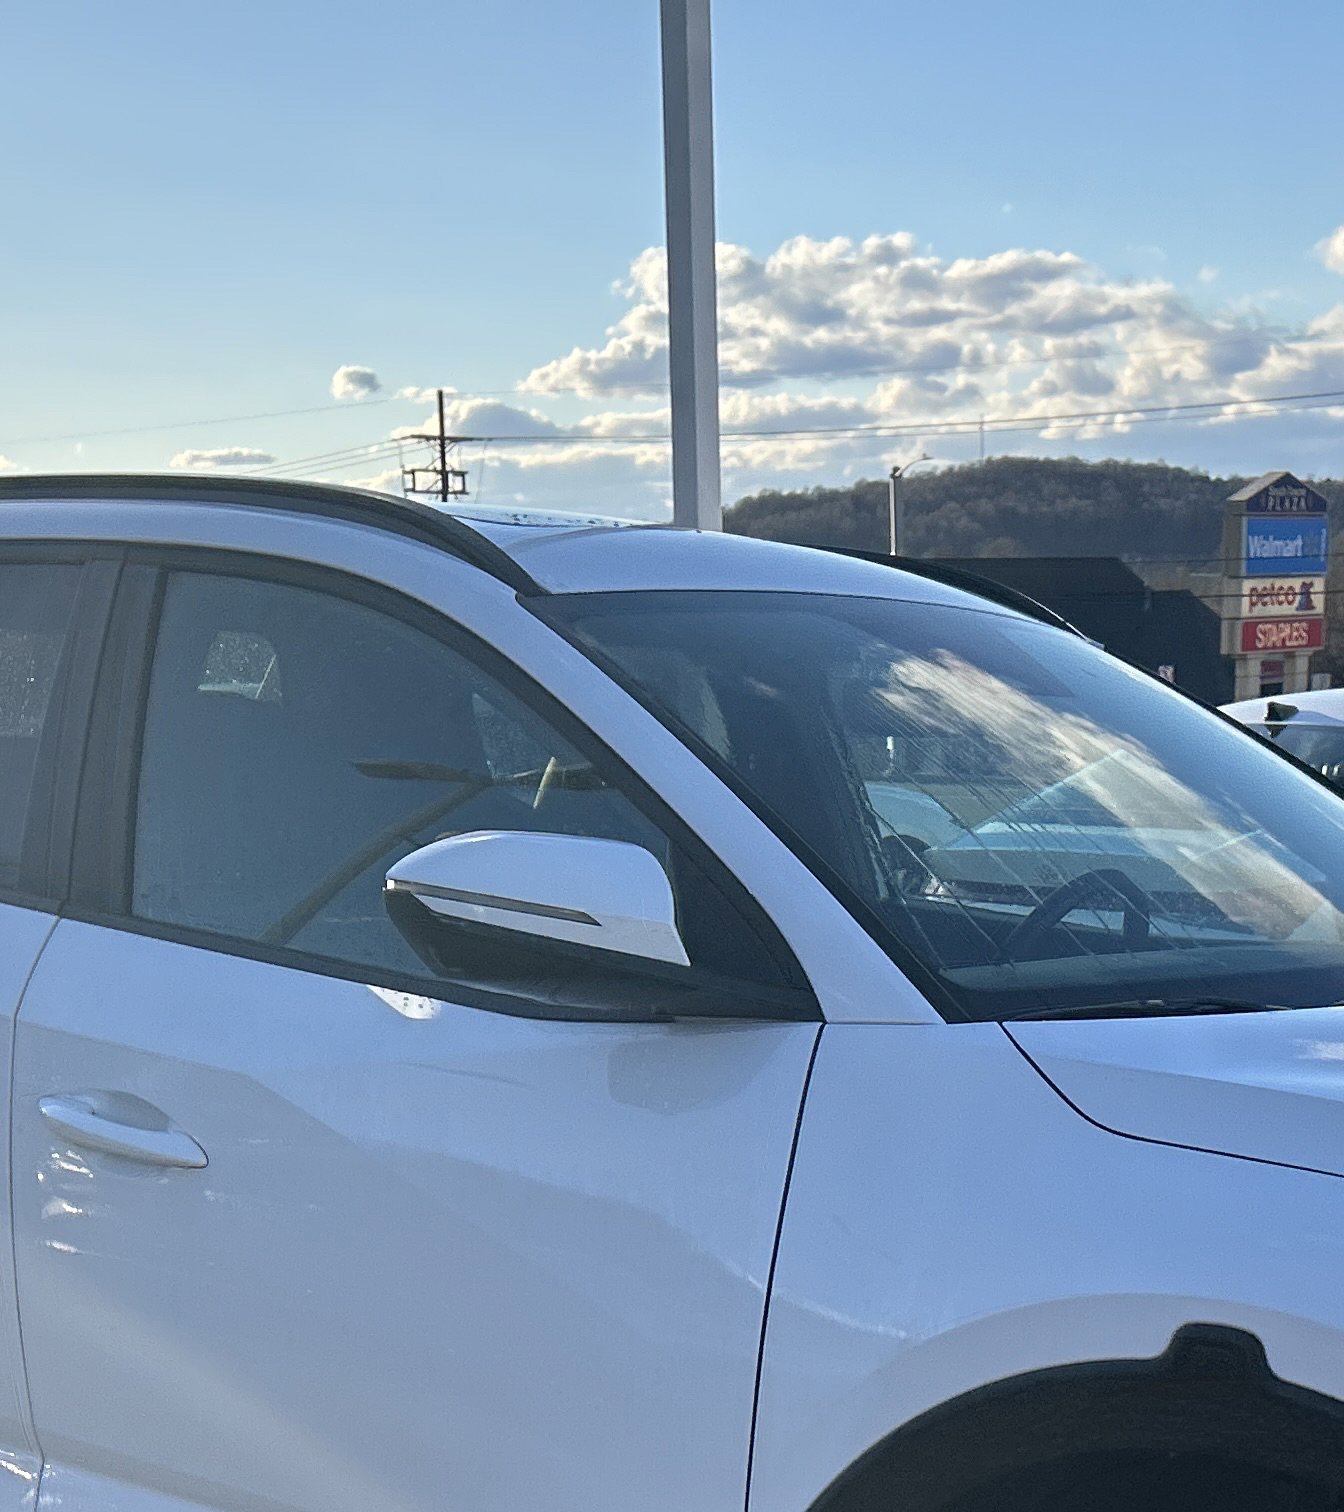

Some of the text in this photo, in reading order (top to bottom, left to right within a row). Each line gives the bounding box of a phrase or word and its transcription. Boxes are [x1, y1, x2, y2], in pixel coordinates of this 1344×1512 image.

[1248, 534, 1303, 558] Walmart
[1248, 583, 1296, 613] petco
[1255, 622, 1310, 648] STAPLES
